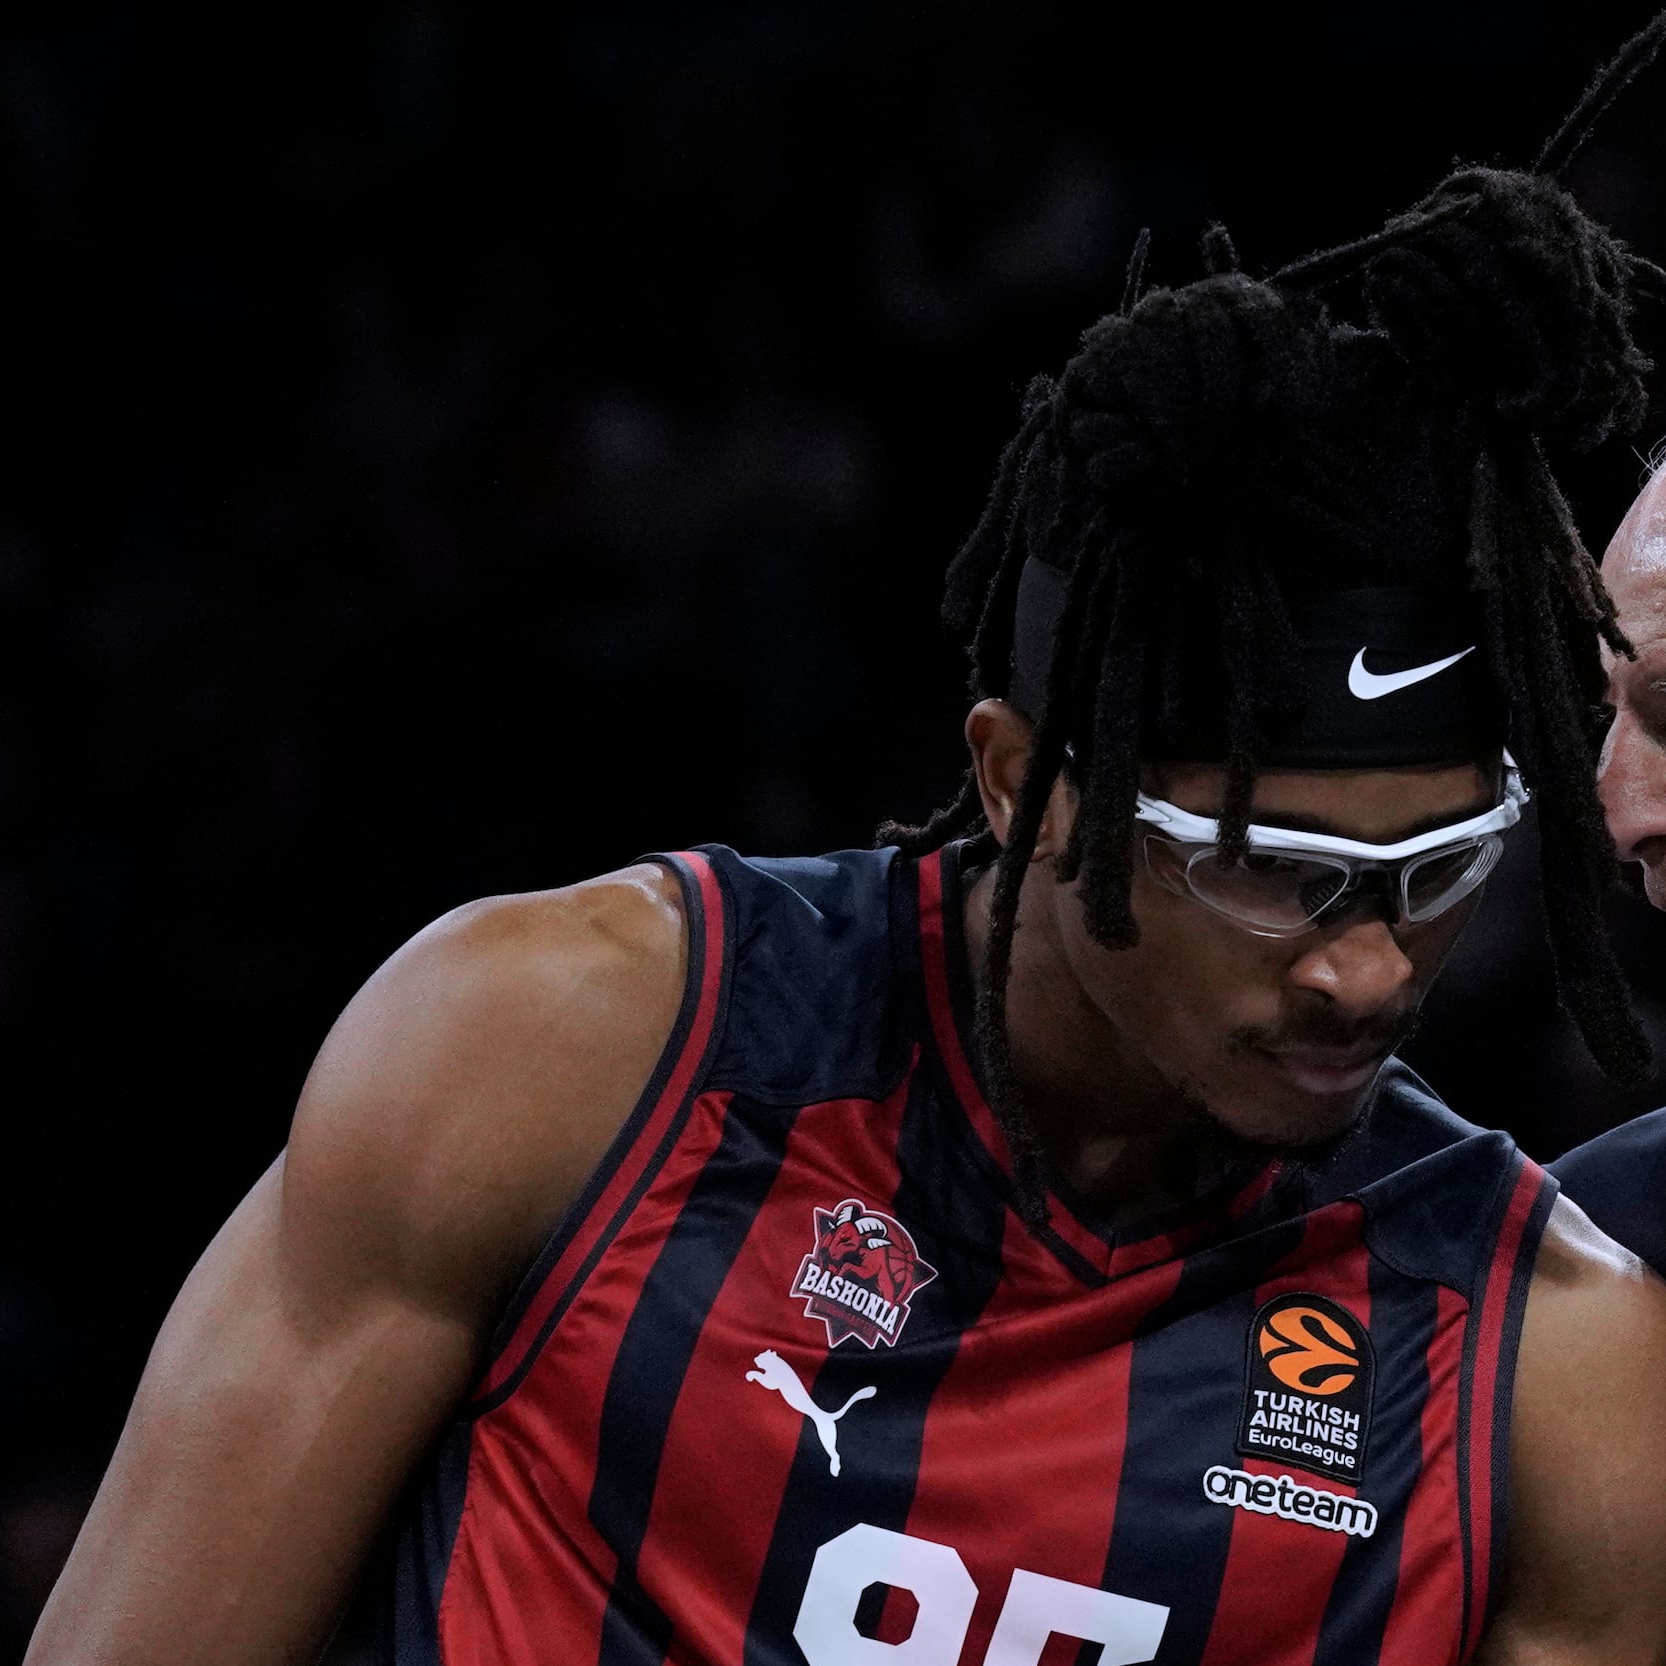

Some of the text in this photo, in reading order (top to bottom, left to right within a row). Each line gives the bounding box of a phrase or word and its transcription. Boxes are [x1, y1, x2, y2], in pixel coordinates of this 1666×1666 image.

[799, 1262, 900, 1336] BASKONIA
[1248, 1409, 1359, 1451] AIRLINES
[1253, 1389, 1361, 1432] TURKISH
[1248, 1428, 1356, 1469] EuroLeague
[1206, 1470, 1373, 1531] oneteam
